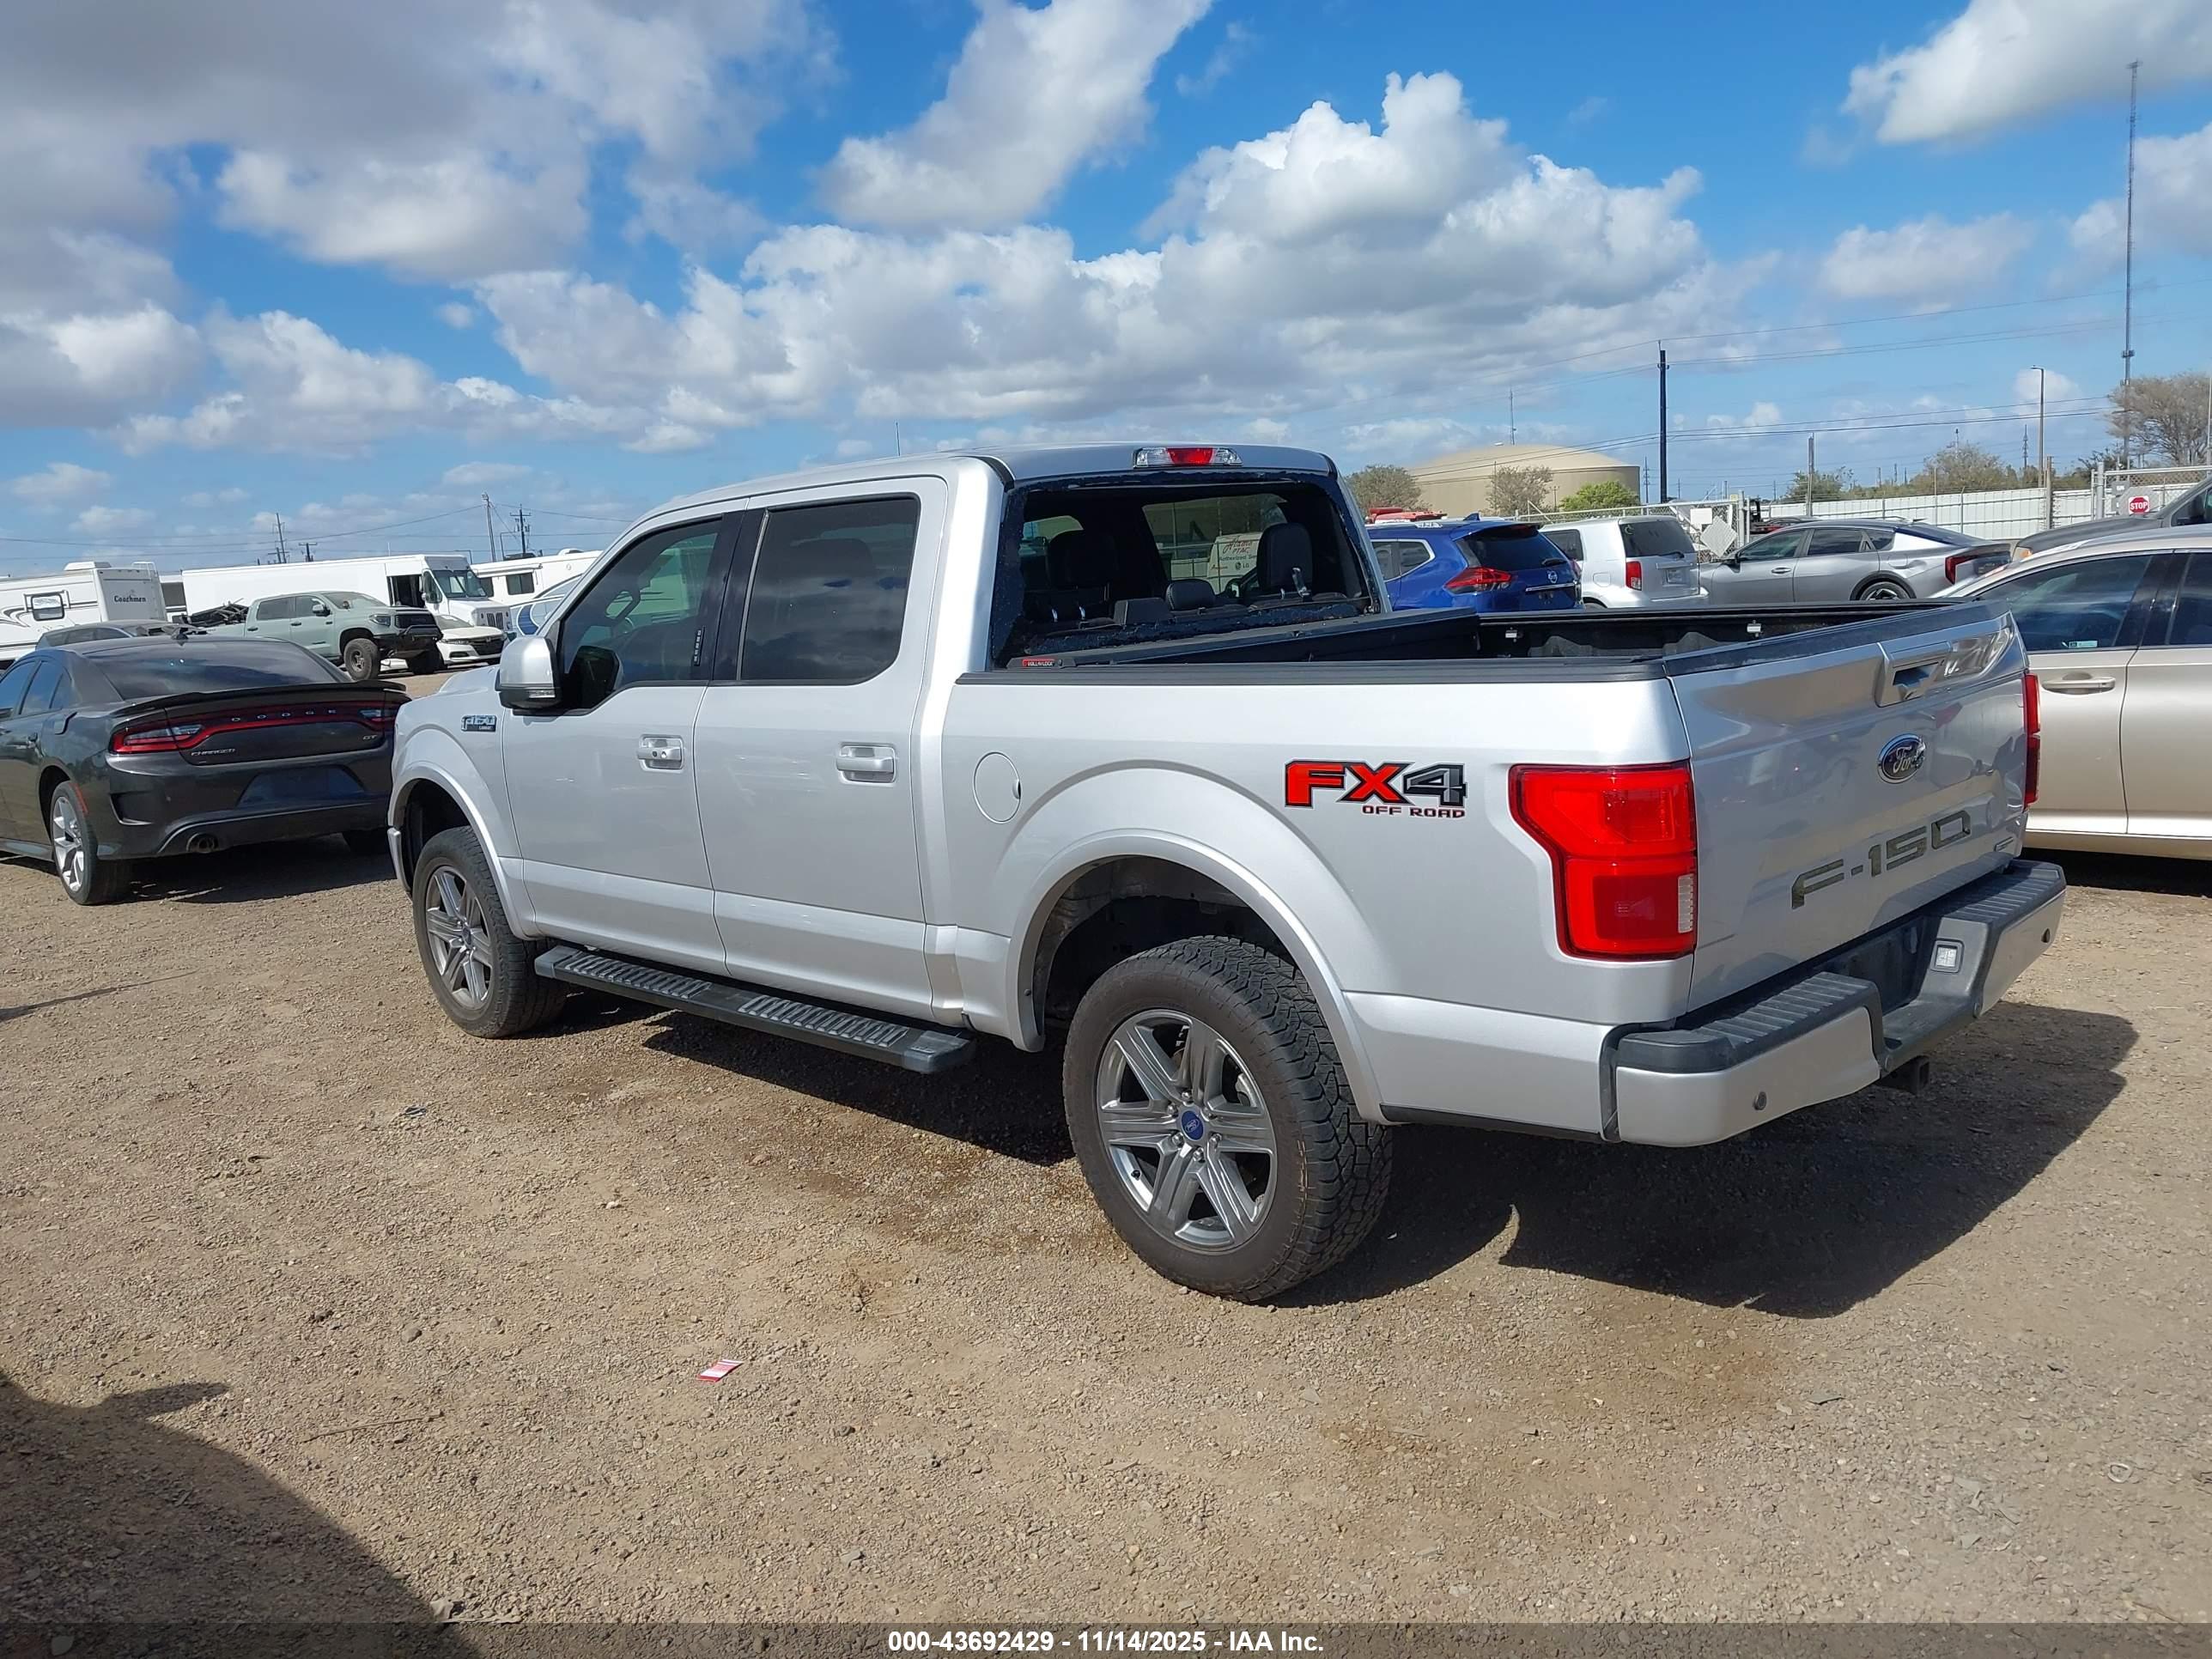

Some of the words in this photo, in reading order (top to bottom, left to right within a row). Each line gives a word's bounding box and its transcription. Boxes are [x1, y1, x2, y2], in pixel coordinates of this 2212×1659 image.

[1285, 760, 1467, 807] FX4
[1362, 805, 1402, 816] OFF
[1410, 807, 1465, 818] ROAD
[1791, 810, 1971, 909] F-150
